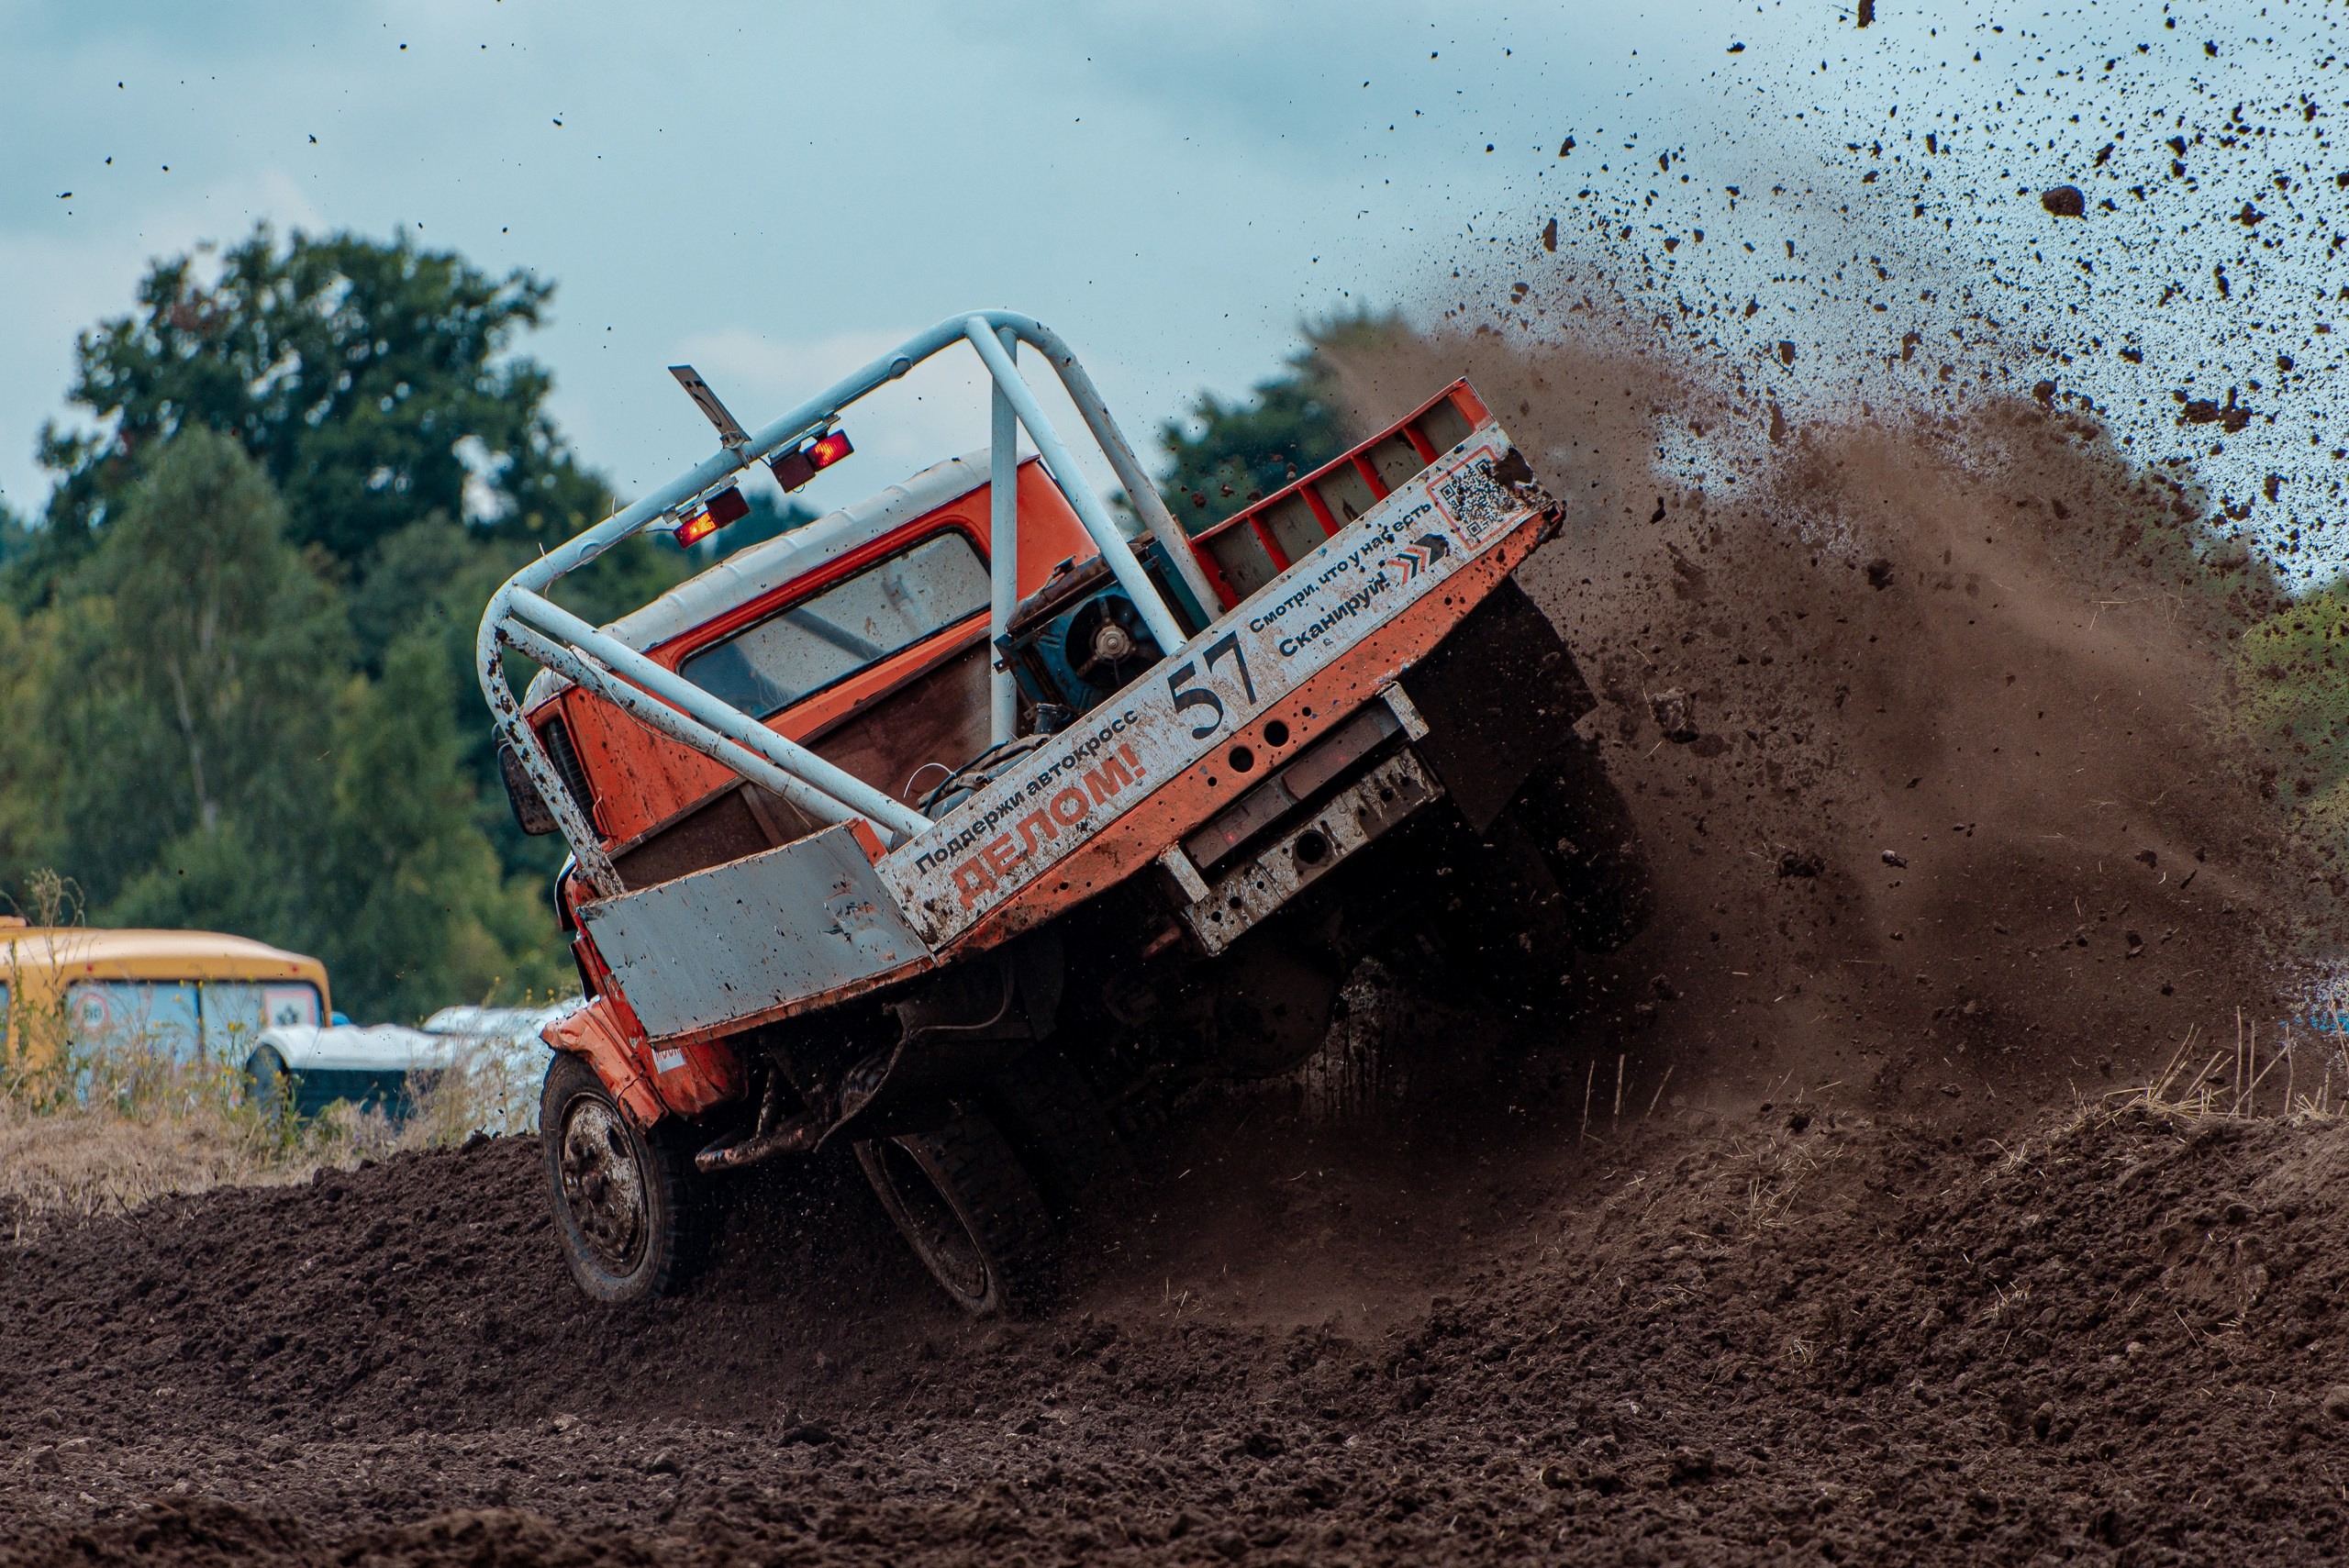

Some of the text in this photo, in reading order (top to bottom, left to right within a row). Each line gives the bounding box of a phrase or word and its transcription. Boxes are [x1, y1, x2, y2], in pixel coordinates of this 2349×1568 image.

[685, 380, 734, 428] 57
[1250, 503, 1432, 633] Смотри, что у нас есть
[1278, 571, 1391, 657] Сканируй!
[1167, 630, 1257, 740] 57
[915, 710, 1139, 874] Поддержи автокросс
[950, 742, 1147, 912] ДЕЛОМ!
